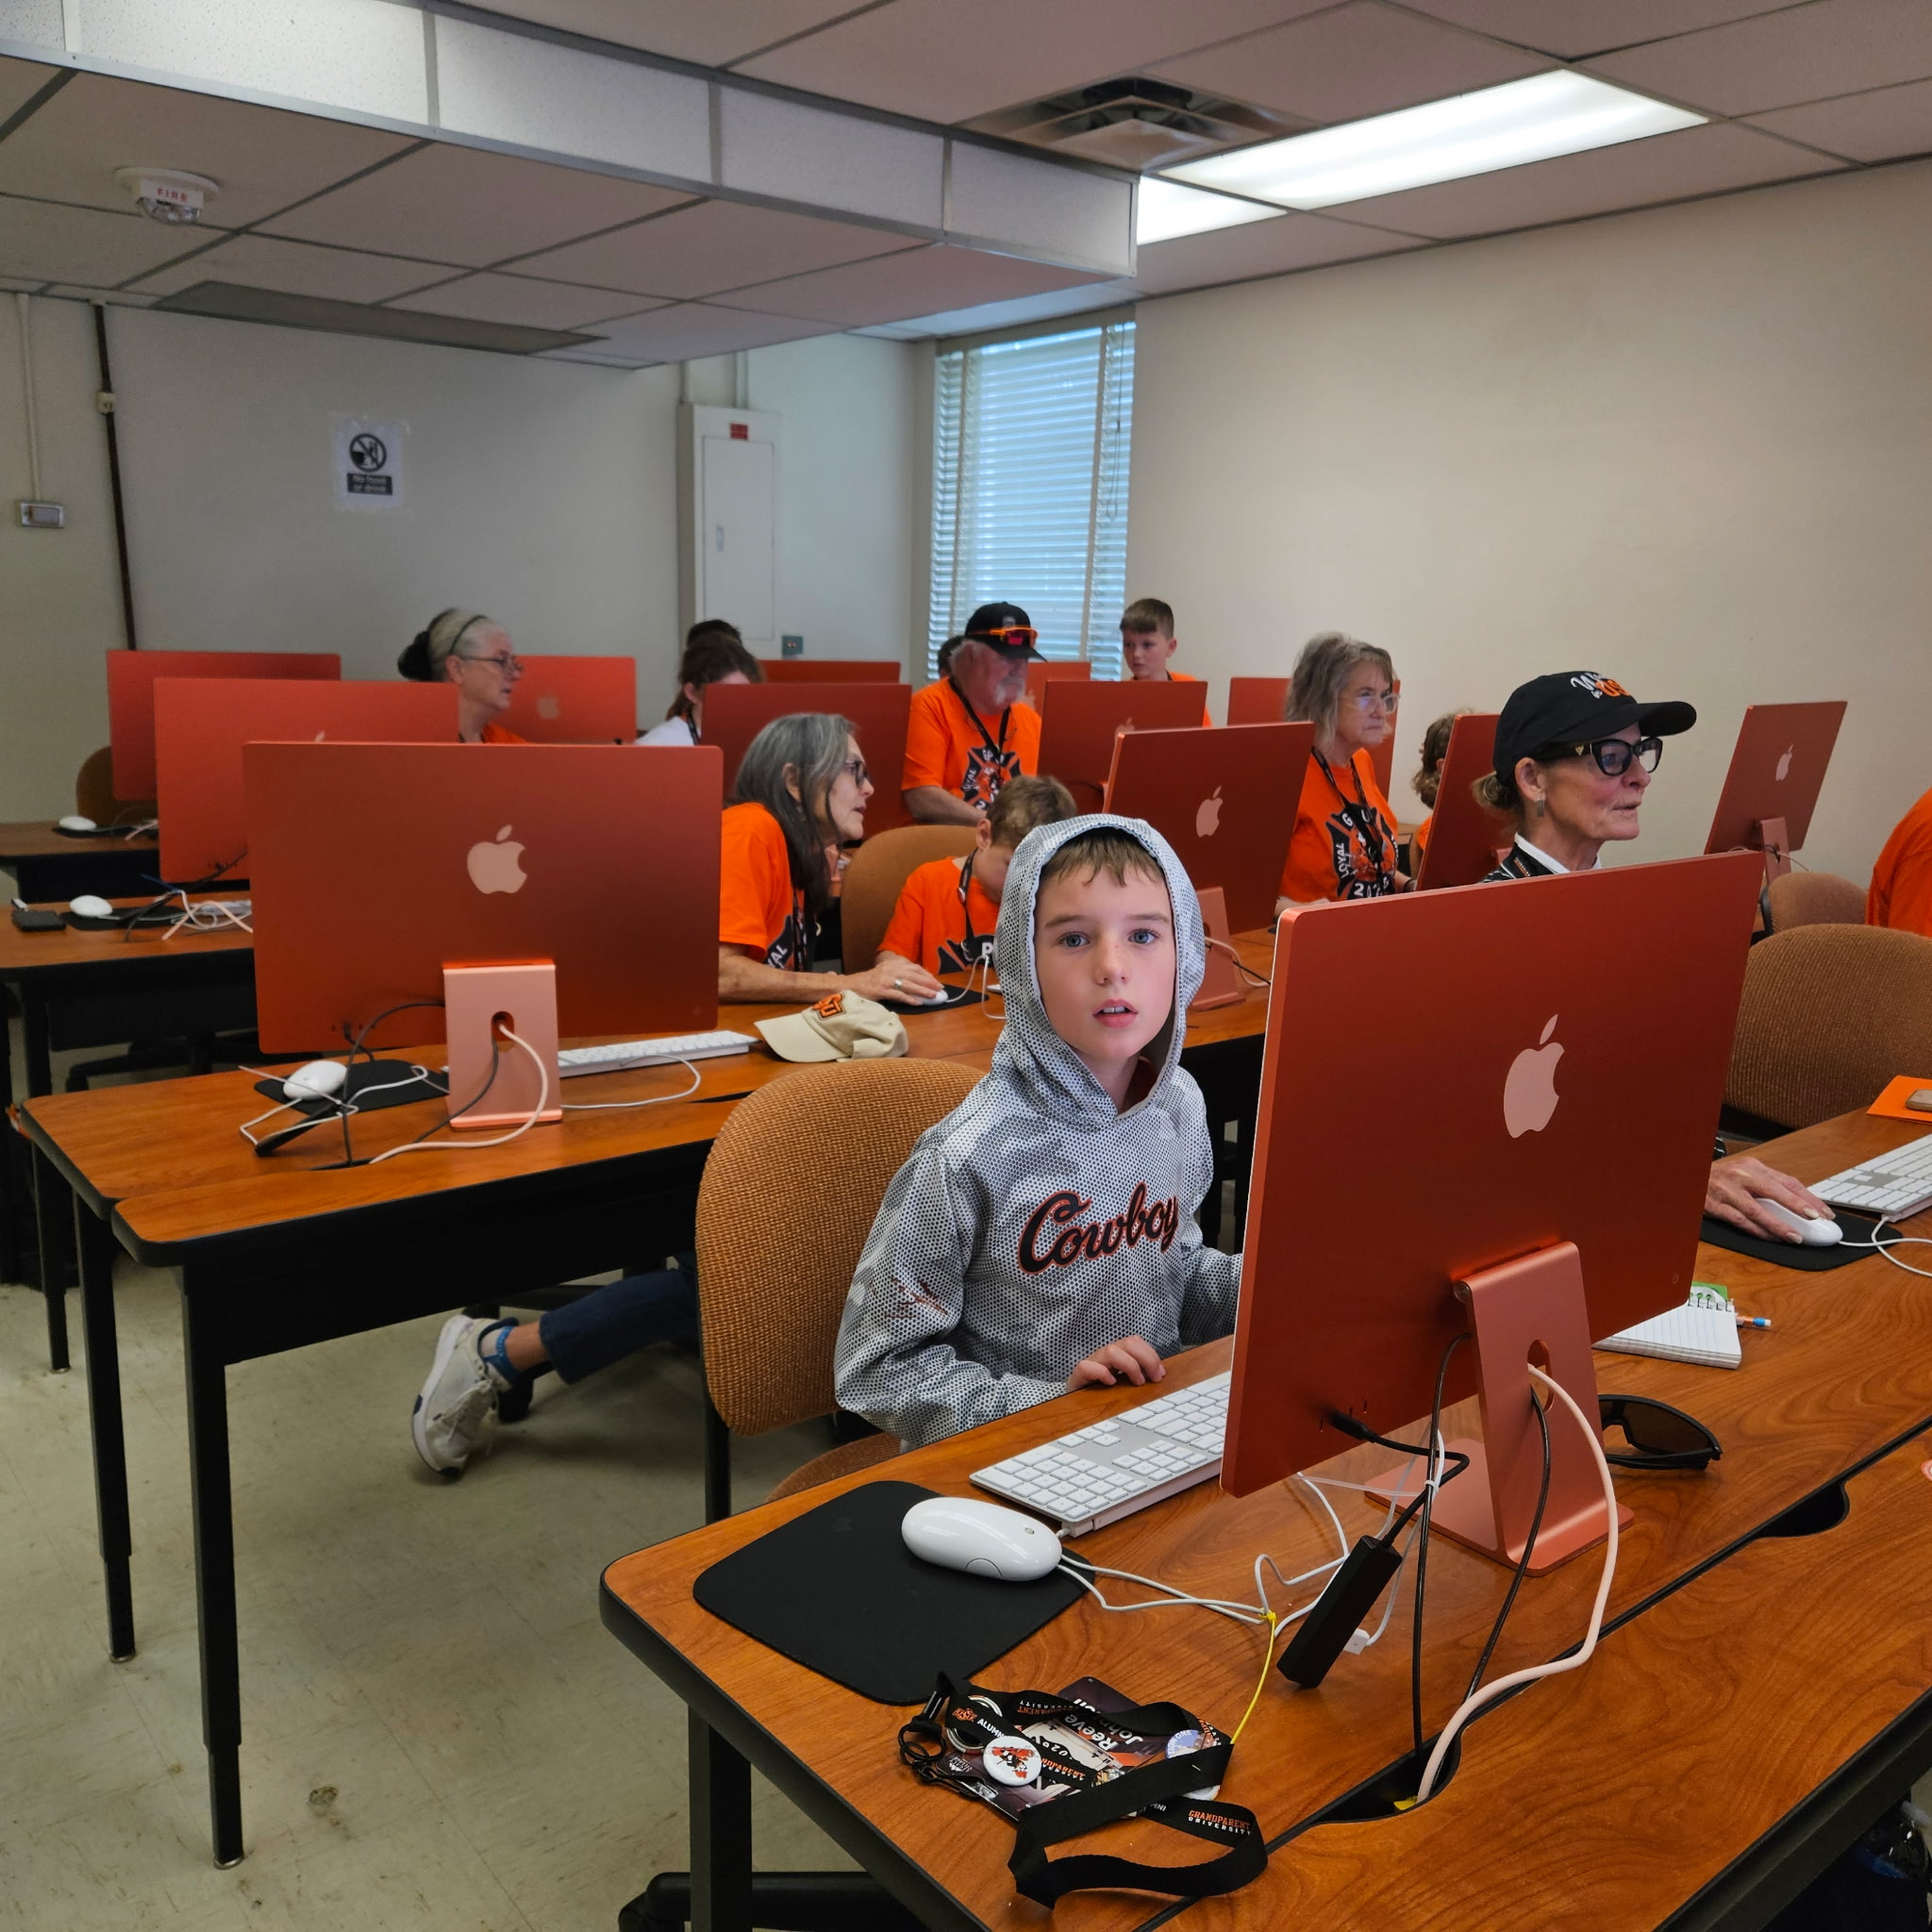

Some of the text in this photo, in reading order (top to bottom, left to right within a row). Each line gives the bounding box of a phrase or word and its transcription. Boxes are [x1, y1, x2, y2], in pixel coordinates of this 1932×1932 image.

[157, 188, 188, 202] FIRE
[1335, 842, 1350, 879] LOYAL
[1063, 1713, 1119, 1751] Reeve
[1188, 1809, 1251, 1830] GRANDPARENT
[1188, 1816, 1252, 1836] UNIVERSITY
